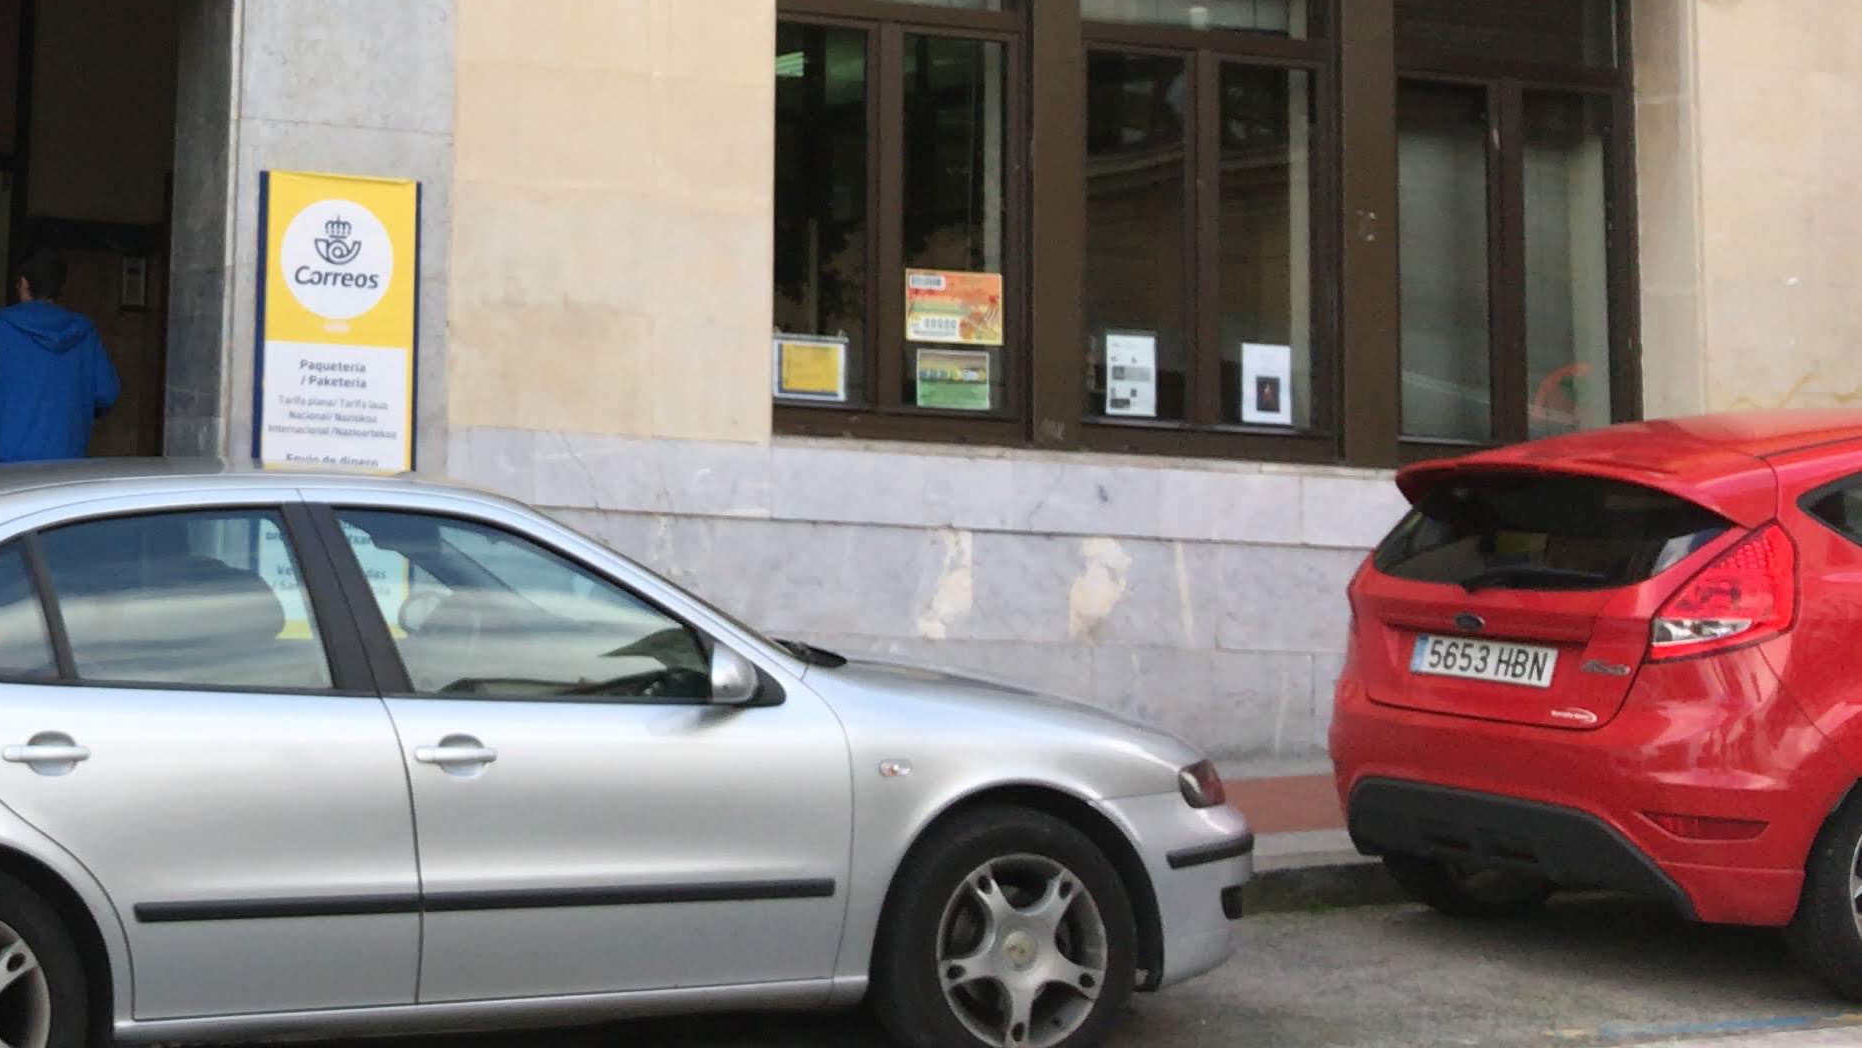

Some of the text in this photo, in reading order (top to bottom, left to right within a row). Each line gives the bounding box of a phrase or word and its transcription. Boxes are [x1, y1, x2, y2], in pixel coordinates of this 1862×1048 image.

[295, 265, 379, 289] Correos
[1428, 638, 1490, 674] 5653
[1493, 646, 1548, 682] HBN
